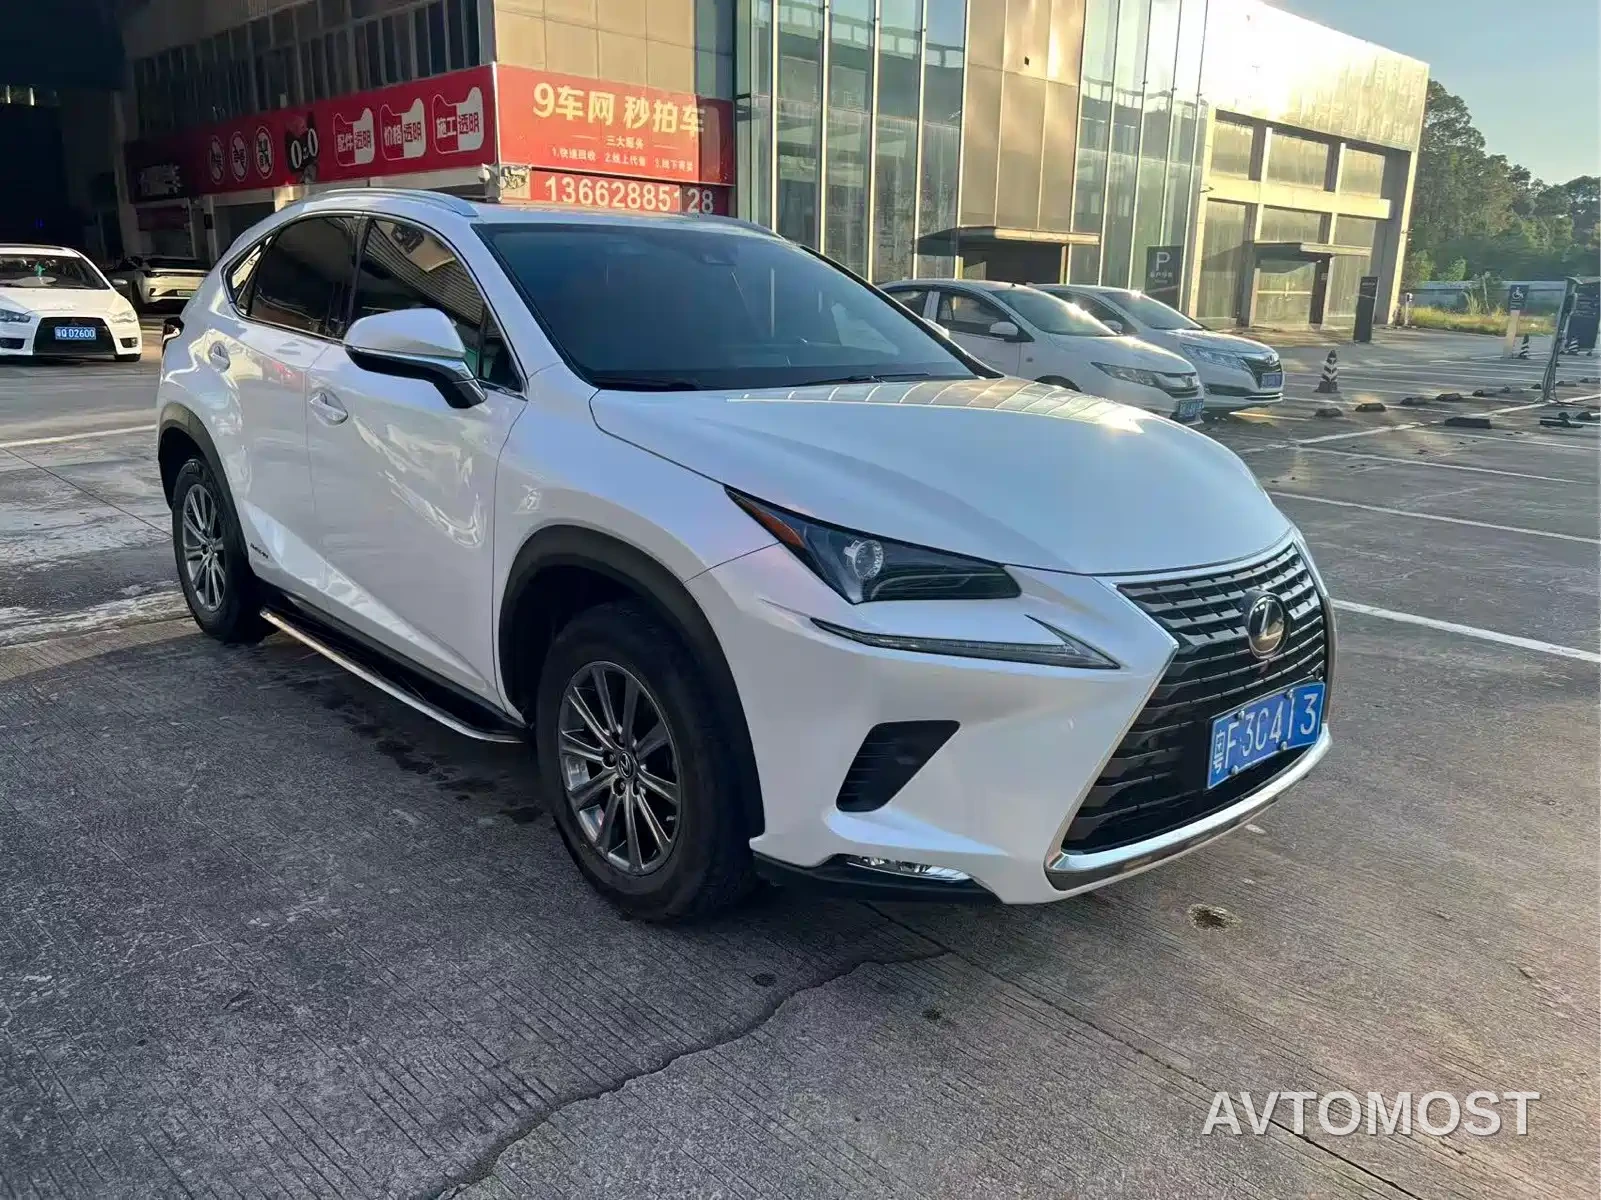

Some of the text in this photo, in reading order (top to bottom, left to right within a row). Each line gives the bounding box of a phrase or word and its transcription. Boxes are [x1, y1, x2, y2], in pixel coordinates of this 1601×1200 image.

[533, 82, 705, 136] 9车网 秒拍车
[1156, 252, 1170, 271] P
